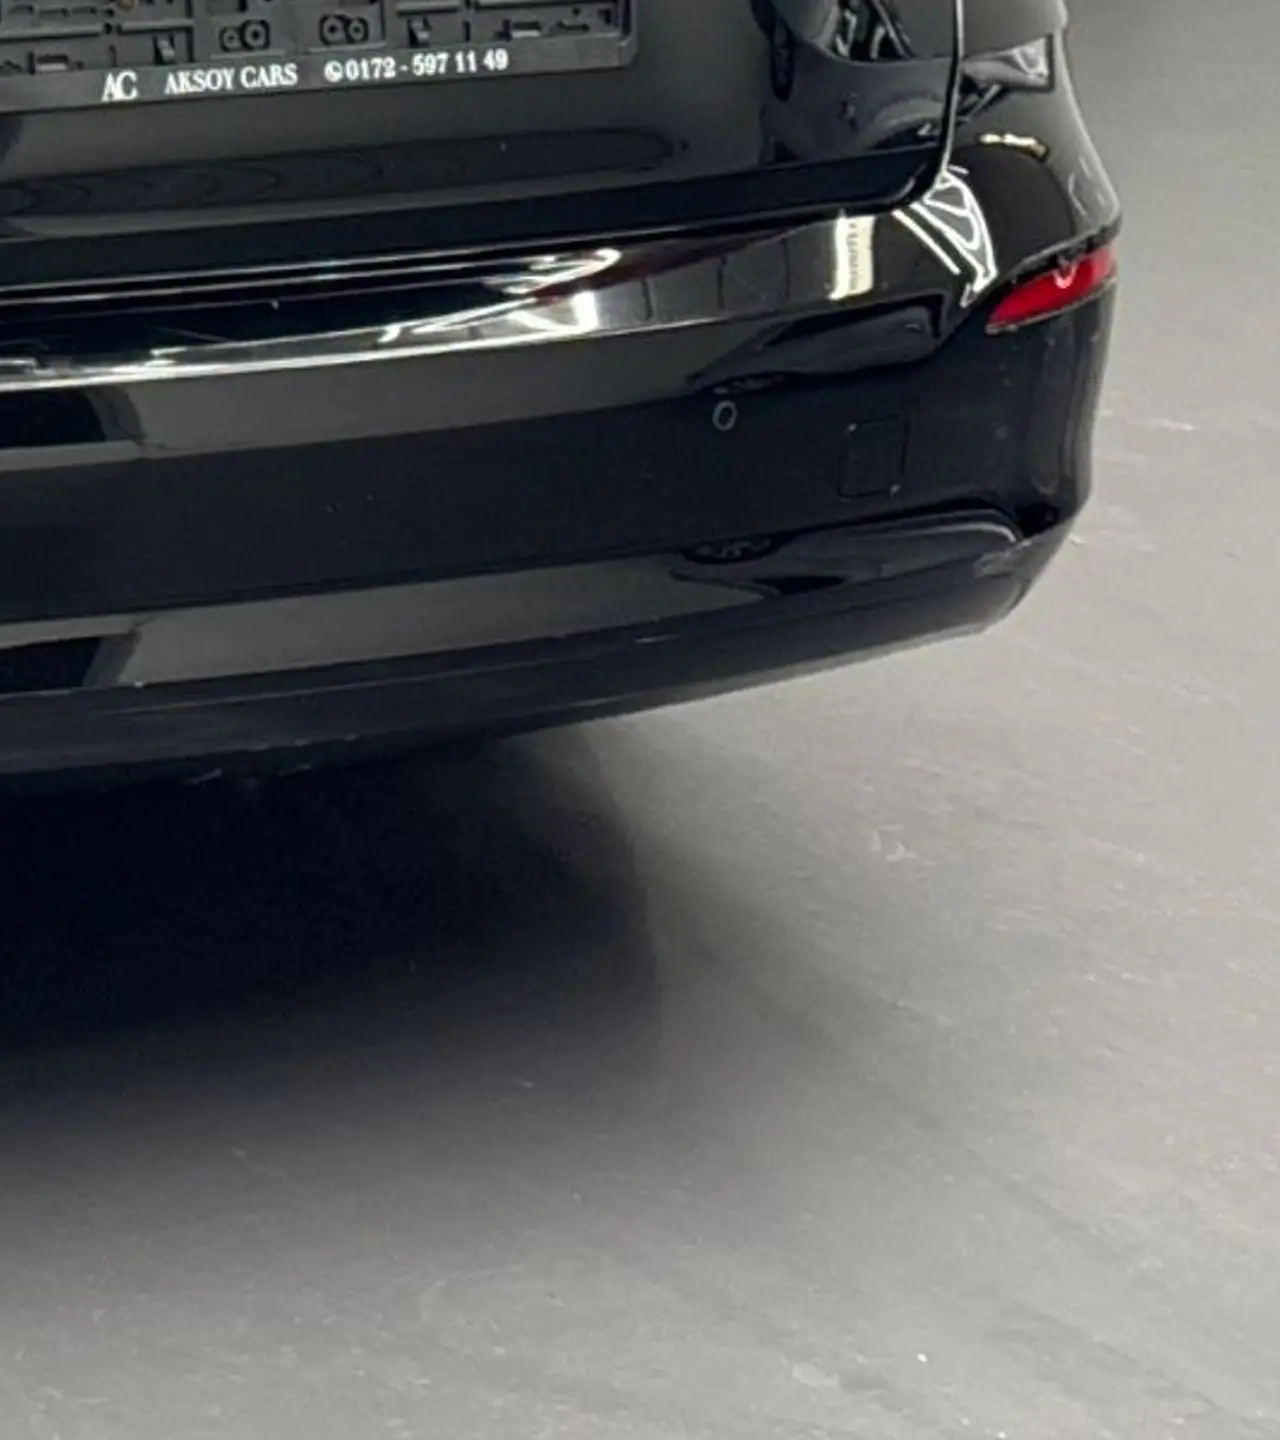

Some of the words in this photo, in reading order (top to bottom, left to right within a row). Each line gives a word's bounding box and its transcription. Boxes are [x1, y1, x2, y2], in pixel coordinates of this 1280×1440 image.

[101, 69, 138, 102] AC
[164, 67, 236, 95] AKSOY
[240, 62, 299, 89] CARS
[411, 51, 450, 76] 597
[455, 49, 478, 74] 11
[482, 47, 509, 71] 49
